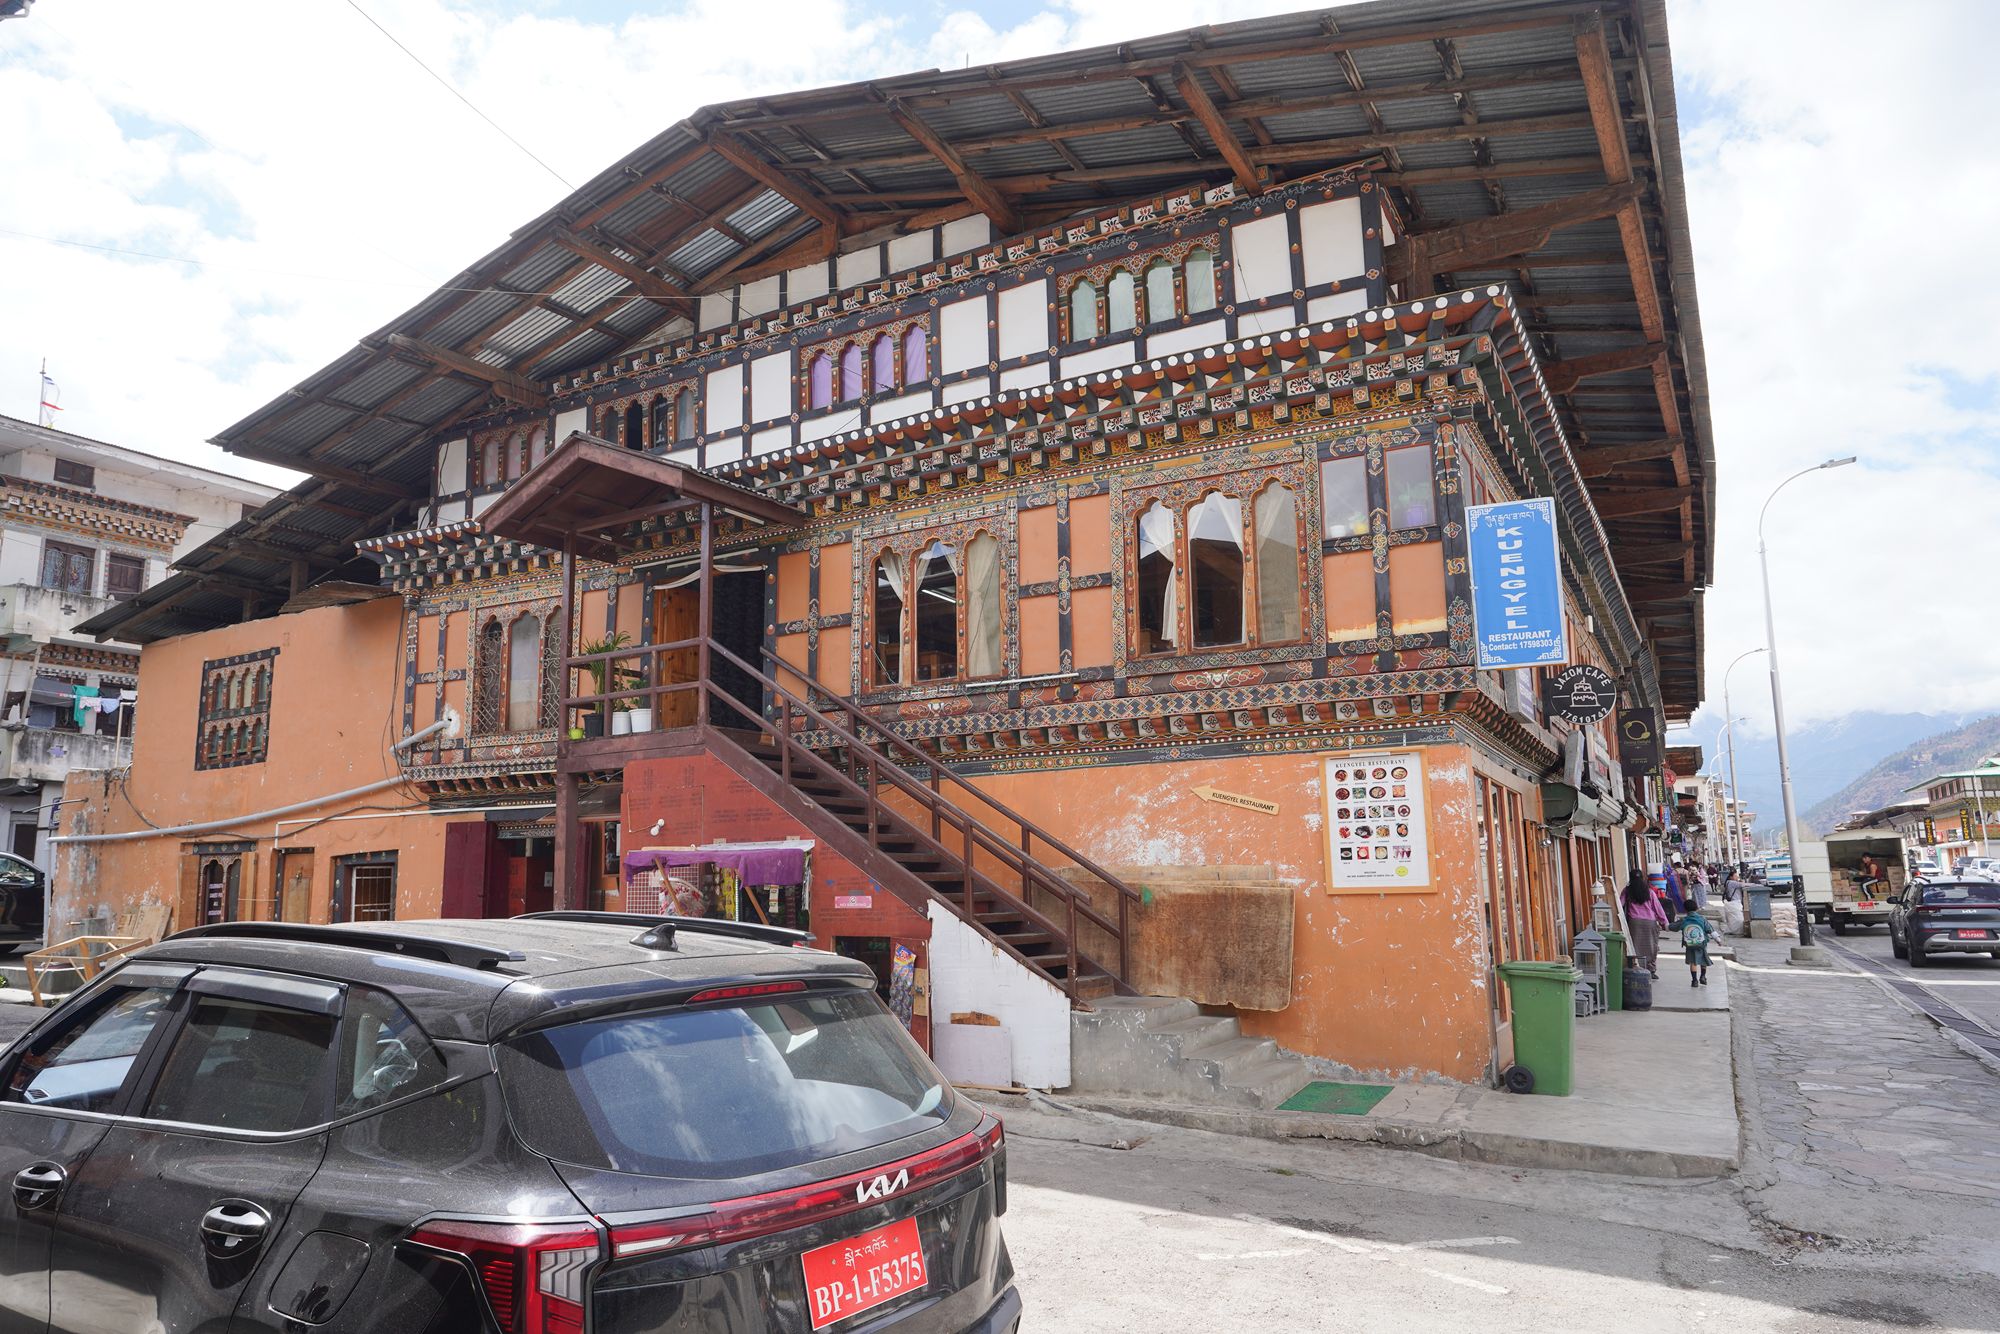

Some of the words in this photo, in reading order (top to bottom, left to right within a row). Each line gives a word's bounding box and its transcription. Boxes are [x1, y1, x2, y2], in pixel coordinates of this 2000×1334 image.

[1496, 526, 1528, 630] KUENGYEL
[1488, 630, 1552, 642] RESTAURANT
[1488, 642, 1518, 651] Contact:
[1520, 639, 1553, 649] 17598303
[1554, 666, 1583, 690] JAZOM
[1585, 667, 1612, 687] CAFÉ
[1211, 792, 1239, 804] KUENGYEL
[1239, 798, 1275, 811] RESTAURANT
[855, 1168, 909, 1204] KIA
[814, 1251, 922, 1320] BP-1-F5375
